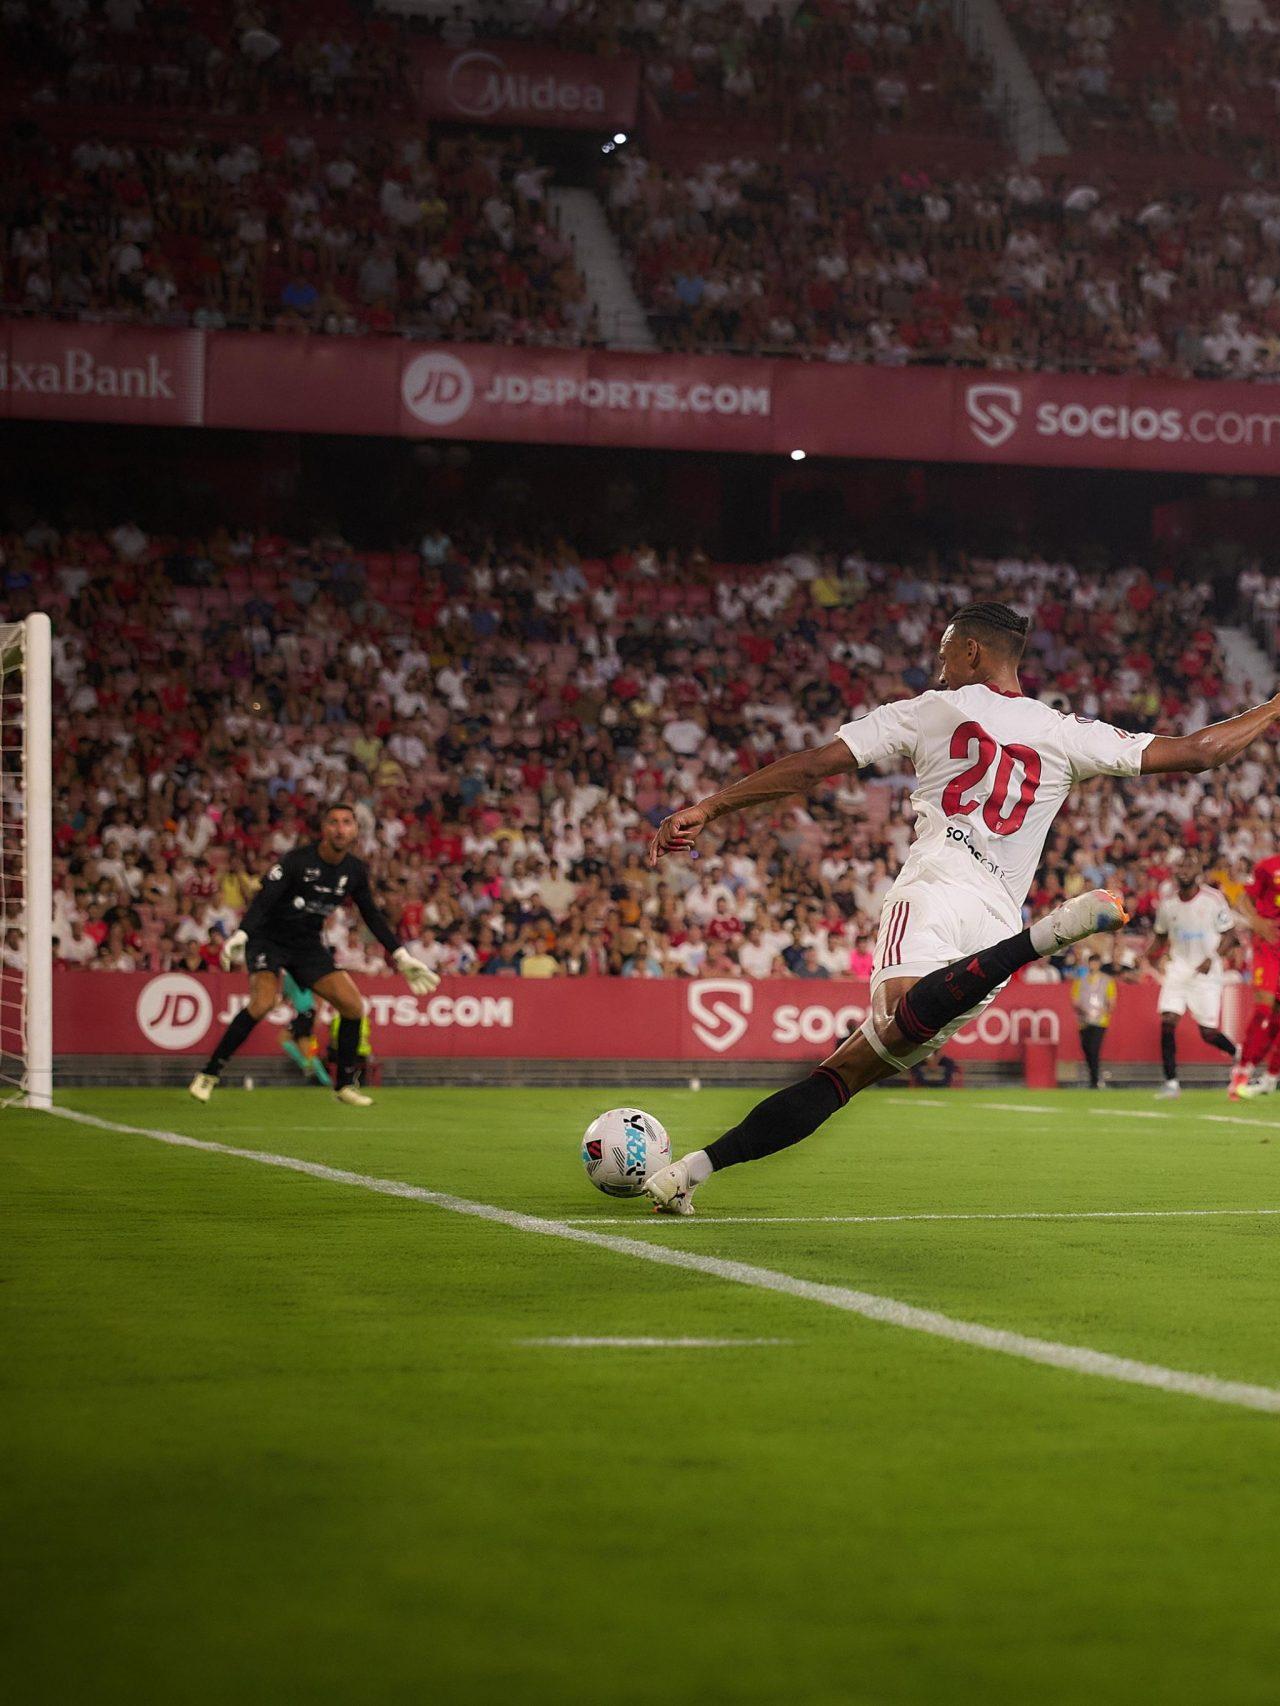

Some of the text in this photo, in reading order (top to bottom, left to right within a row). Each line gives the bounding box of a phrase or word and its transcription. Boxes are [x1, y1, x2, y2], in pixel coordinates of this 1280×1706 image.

[414, 372, 463, 406] JD
[485, 376, 771, 417] JDSPORTS.COM
[941, 720, 1041, 836] 20
[149, 993, 200, 1028] JD
